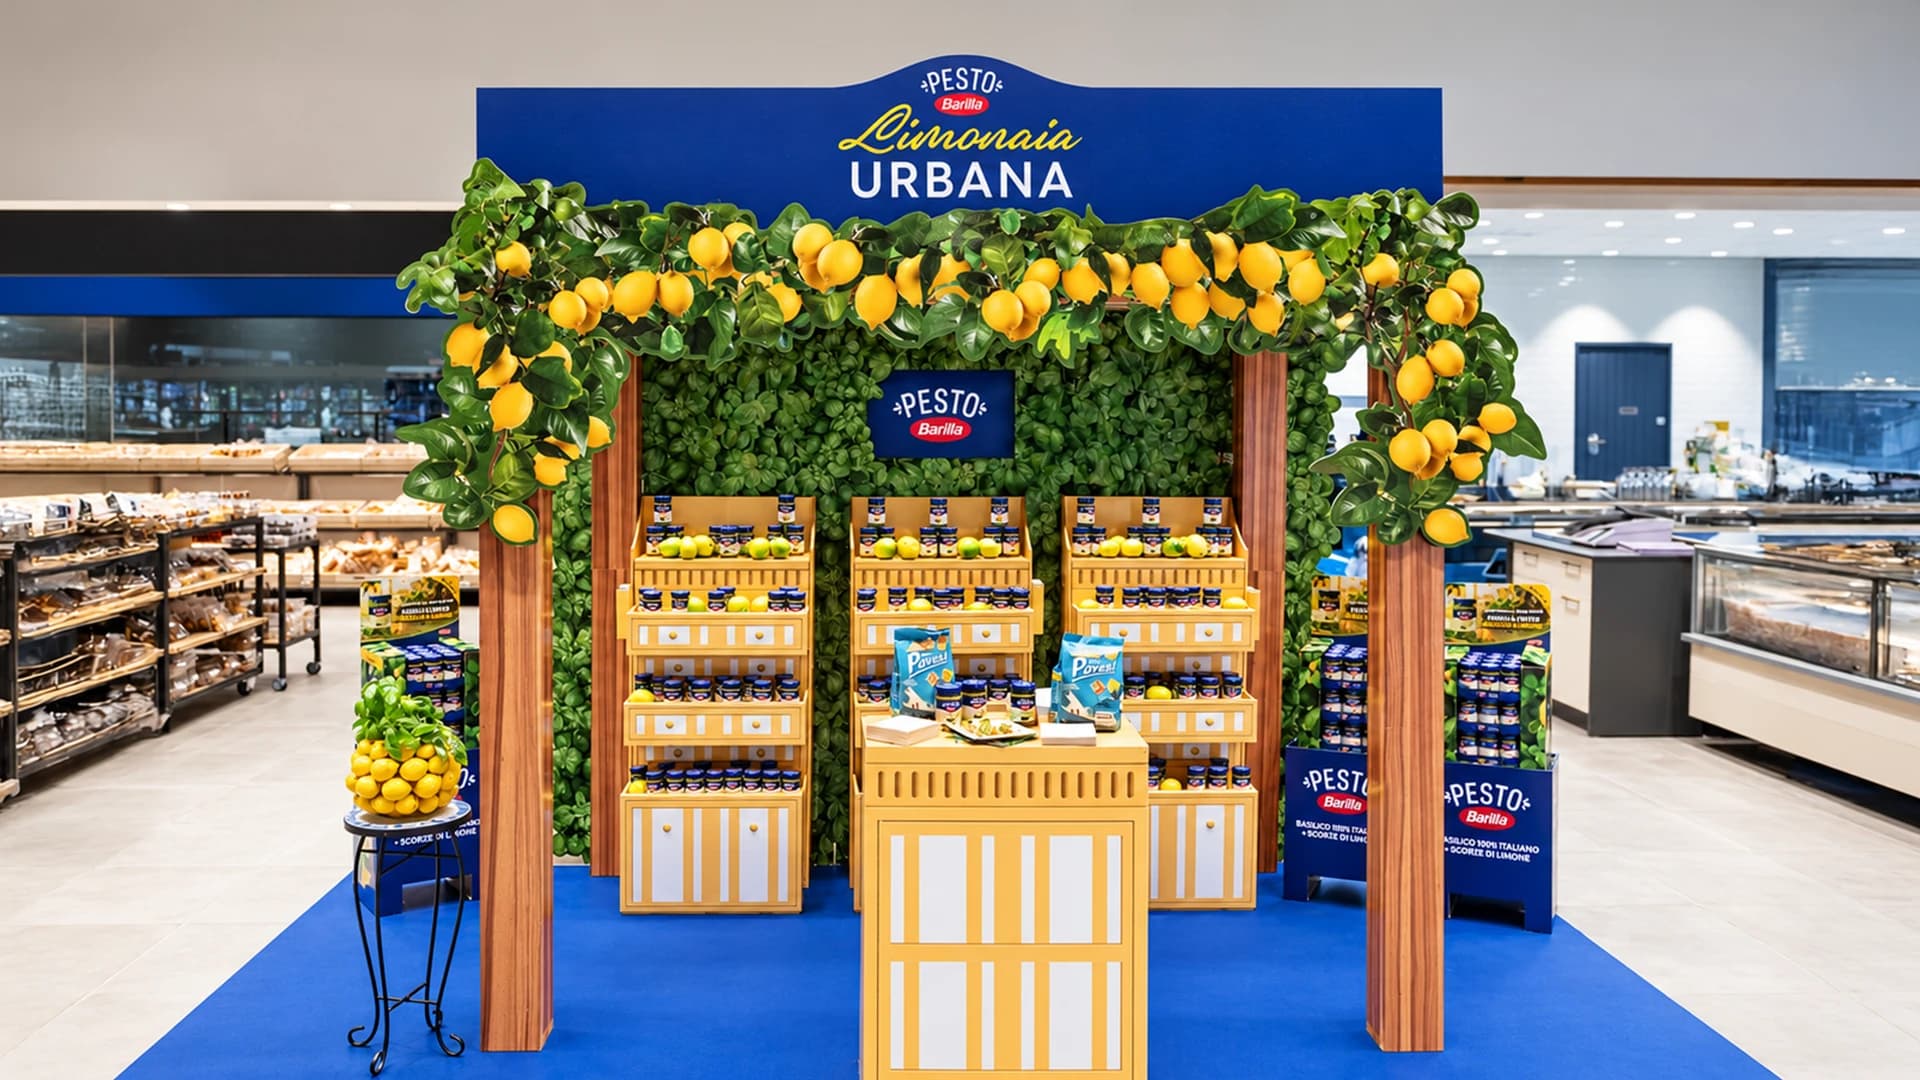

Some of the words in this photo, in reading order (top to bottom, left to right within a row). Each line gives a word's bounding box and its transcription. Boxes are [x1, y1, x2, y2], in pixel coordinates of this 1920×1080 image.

[926, 67, 997, 94] PESTO
[941, 98, 983, 110] Barilla
[838, 103, 1082, 154] Limonaia
[850, 161, 1074, 198] URBANA
[900, 387, 981, 418] PESTO
[917, 422, 964, 436] Barilla
[1323, 795, 1362, 811] Barilla
[1449, 782, 1523, 811] PESTO
[1465, 810, 1508, 826] Barilla
[1450, 846, 1484, 857] SCORZE
[1485, 850, 1495, 858] DI
[1496, 851, 1531, 863] LIMONE
[1499, 842, 1540, 854] ITALIANO
